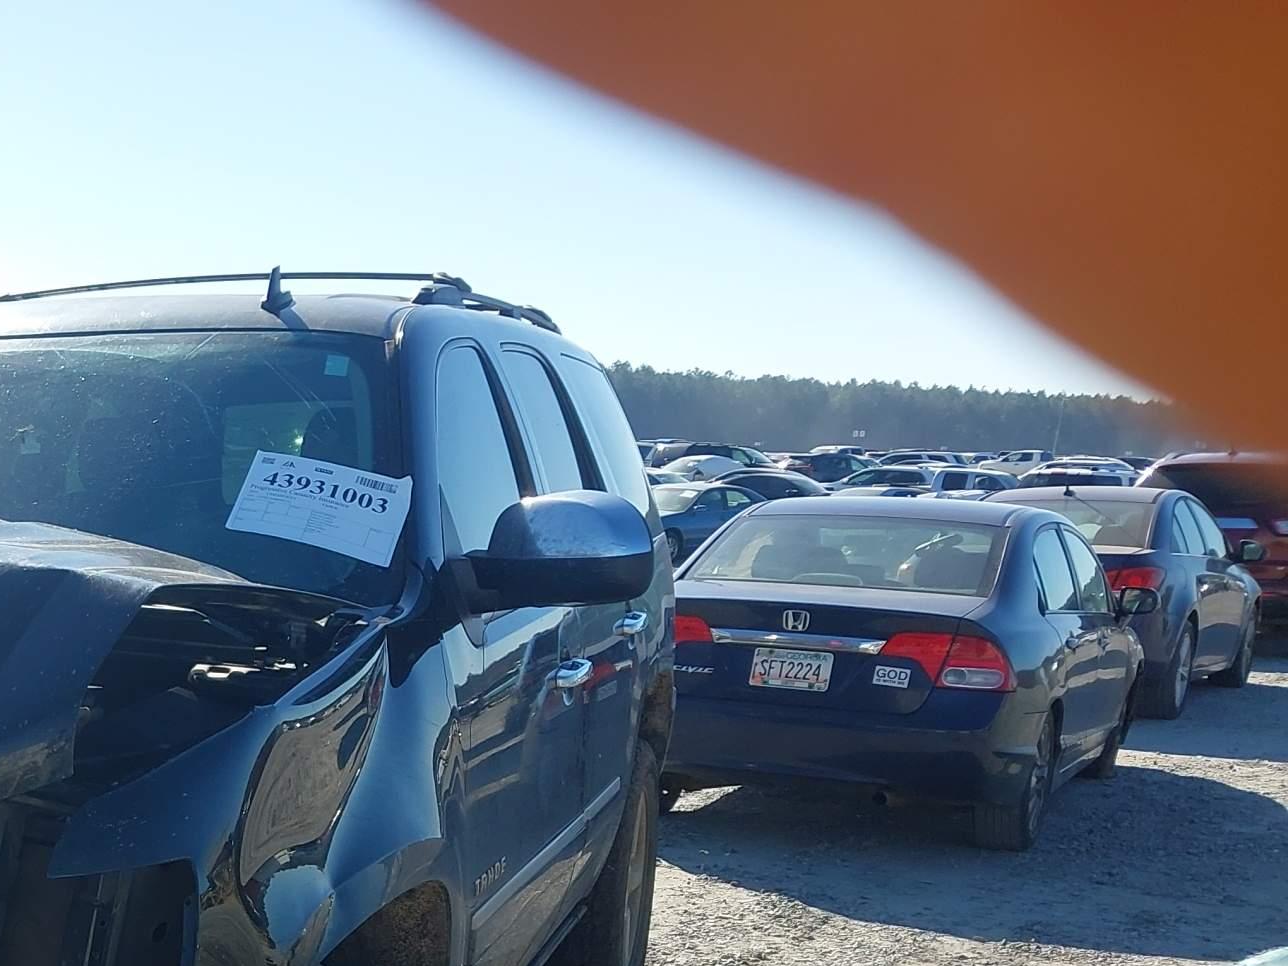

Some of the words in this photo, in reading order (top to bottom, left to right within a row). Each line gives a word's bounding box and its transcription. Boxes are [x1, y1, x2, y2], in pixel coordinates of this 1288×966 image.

[263, 472, 389, 514] 43931003
[673, 664, 715, 674] CIVIC
[759, 659, 822, 682] SFT2224
[876, 668, 908, 681] GOD
[475, 856, 506, 897] TAHOE
